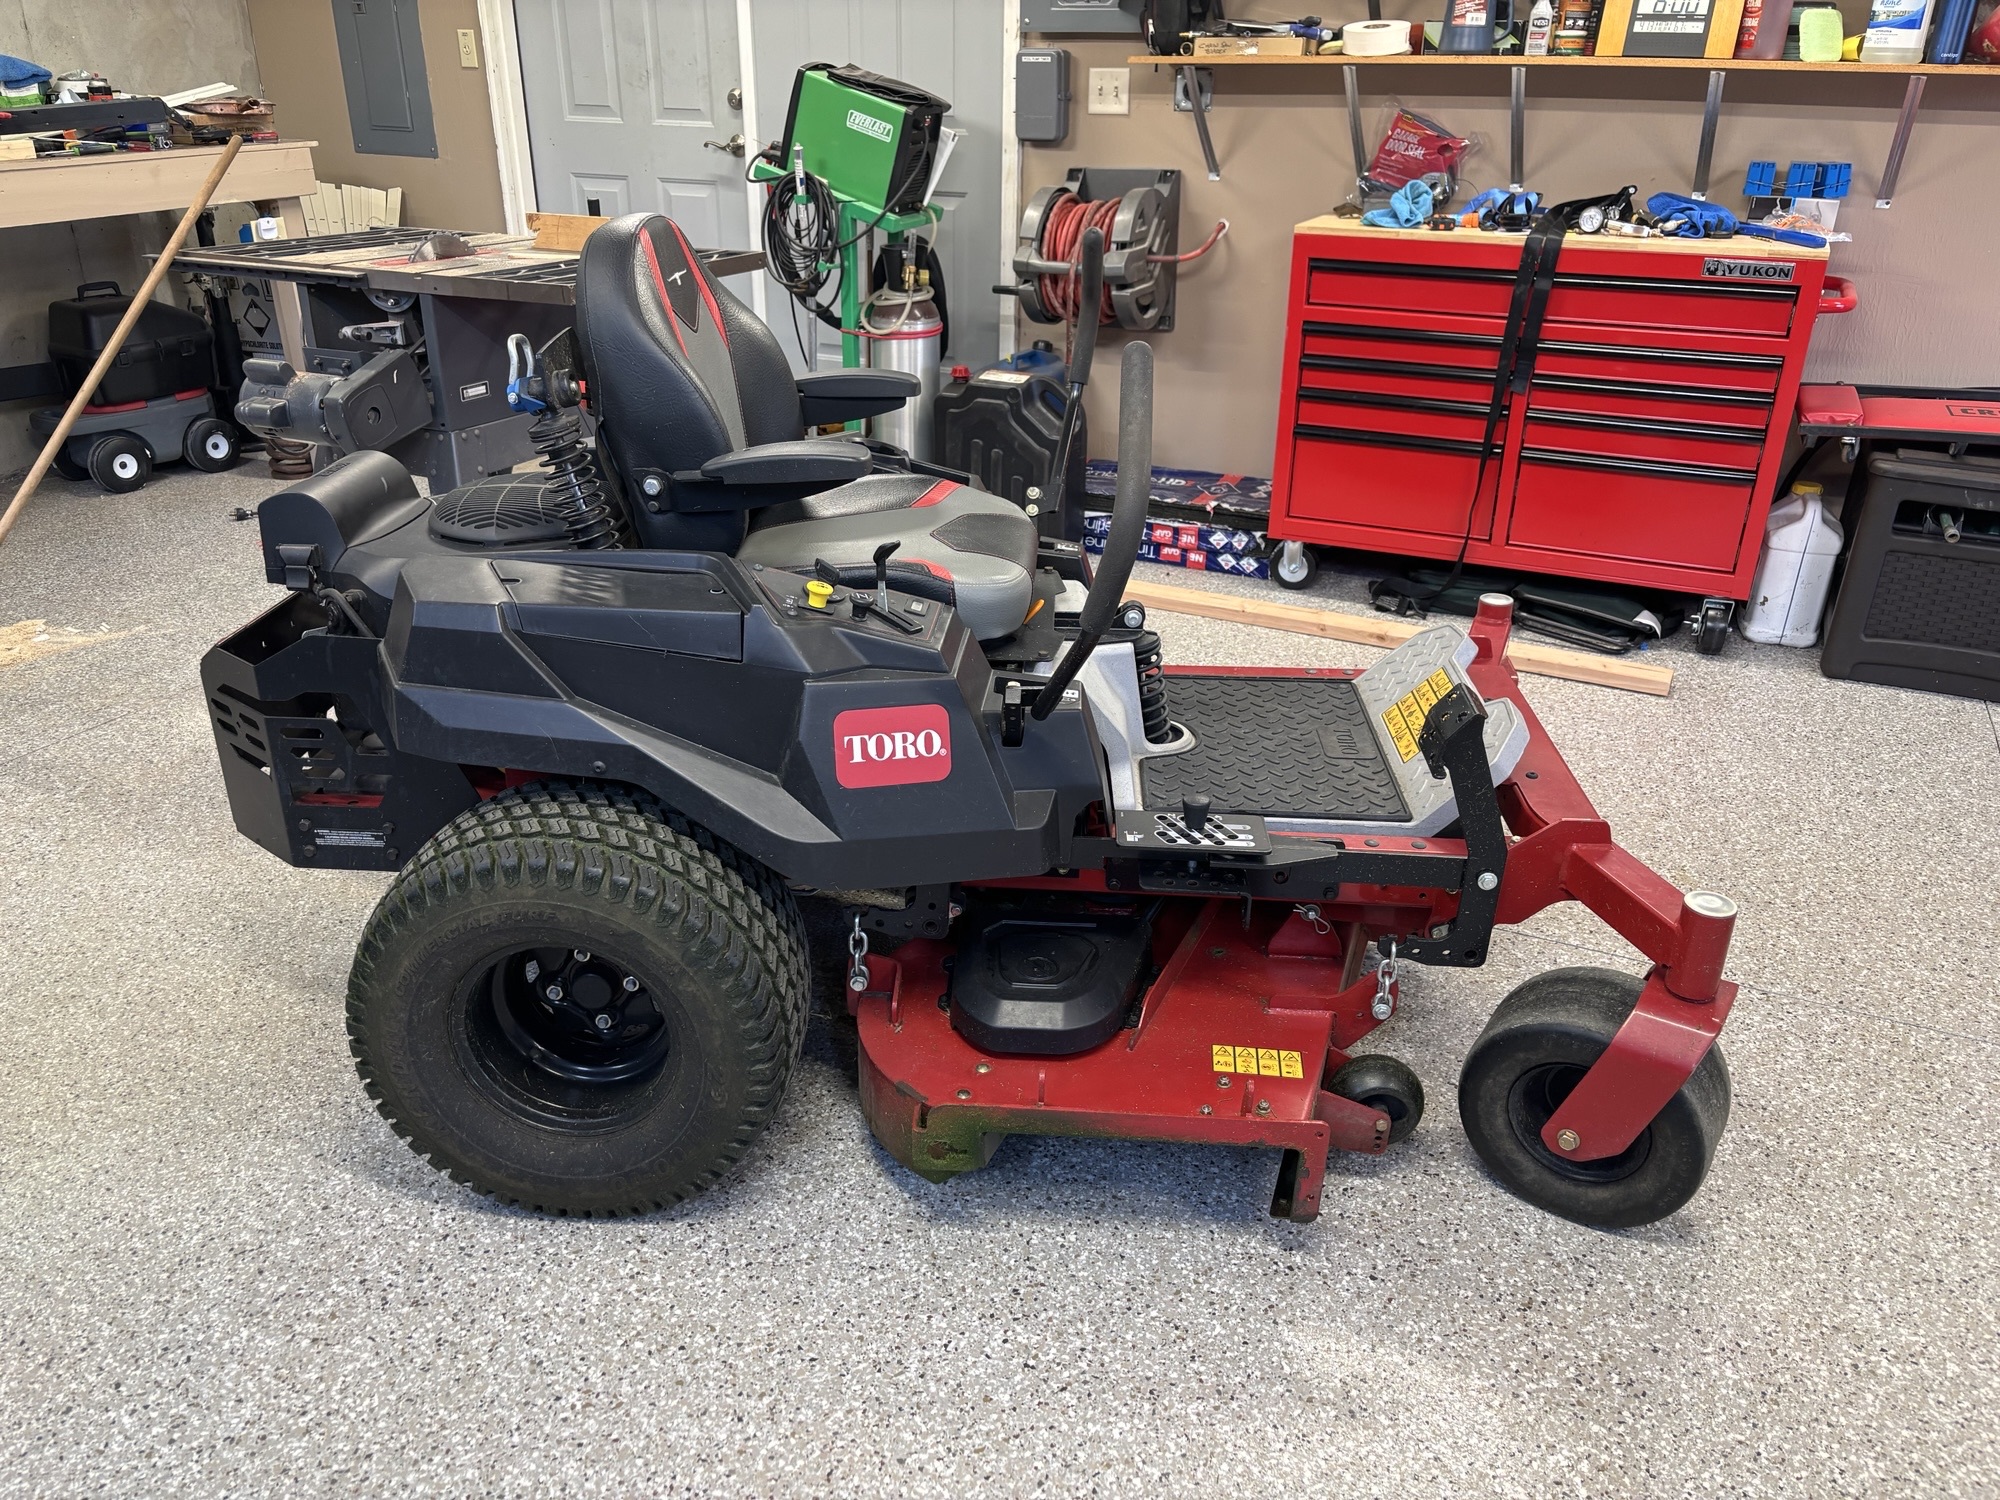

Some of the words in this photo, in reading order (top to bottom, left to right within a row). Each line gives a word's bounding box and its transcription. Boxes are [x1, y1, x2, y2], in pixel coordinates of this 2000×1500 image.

[850, 113, 891, 135] EVERLAST
[1726, 264, 1791, 279] YUKON
[1960, 408, 2000, 416] CR
[1161, 547, 1180, 556] GAF
[844, 729, 942, 763] TORO
